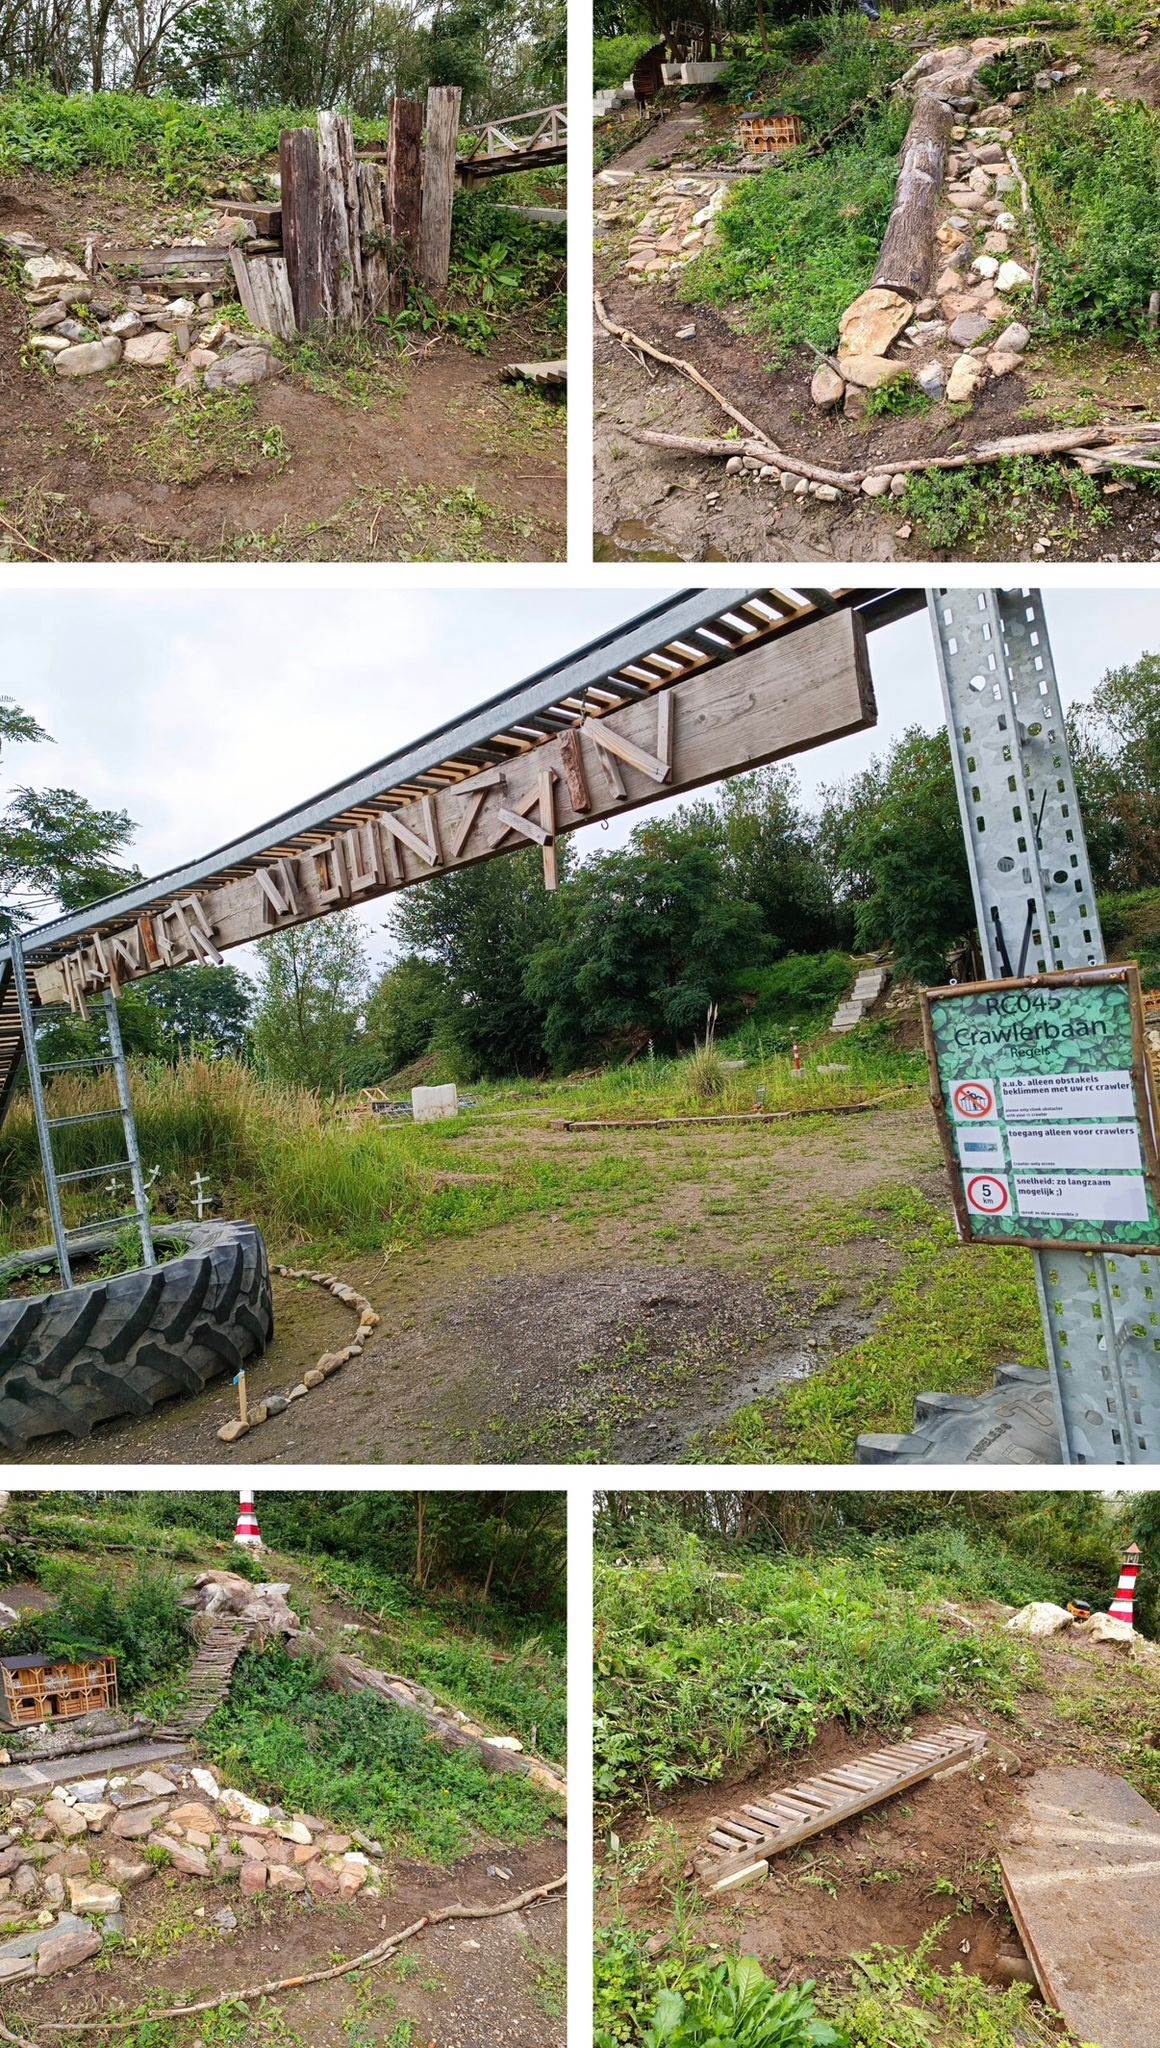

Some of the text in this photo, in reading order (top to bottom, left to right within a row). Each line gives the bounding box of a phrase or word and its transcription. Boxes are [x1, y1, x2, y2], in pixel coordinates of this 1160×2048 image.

[986, 994, 1061, 1016] RC045
[954, 1019, 1107, 1046] Crawlerbaan
[1010, 1045, 1051, 1059] Regels
[1002, 1075, 1099, 1087] a.u.b. alleen obstakels
[1003, 1082, 1130, 1096] beklimmen met uw rc crawler
[1008, 1130, 1043, 1138] toegang
[1095, 1127, 1134, 1135] crawlers
[1016, 1178, 1055, 1186] snelheid:
[1067, 1178, 1111, 1188] langzaam
[982, 1184, 992, 1197] 5
[1018, 1187, 1054, 1197] mogelijk
